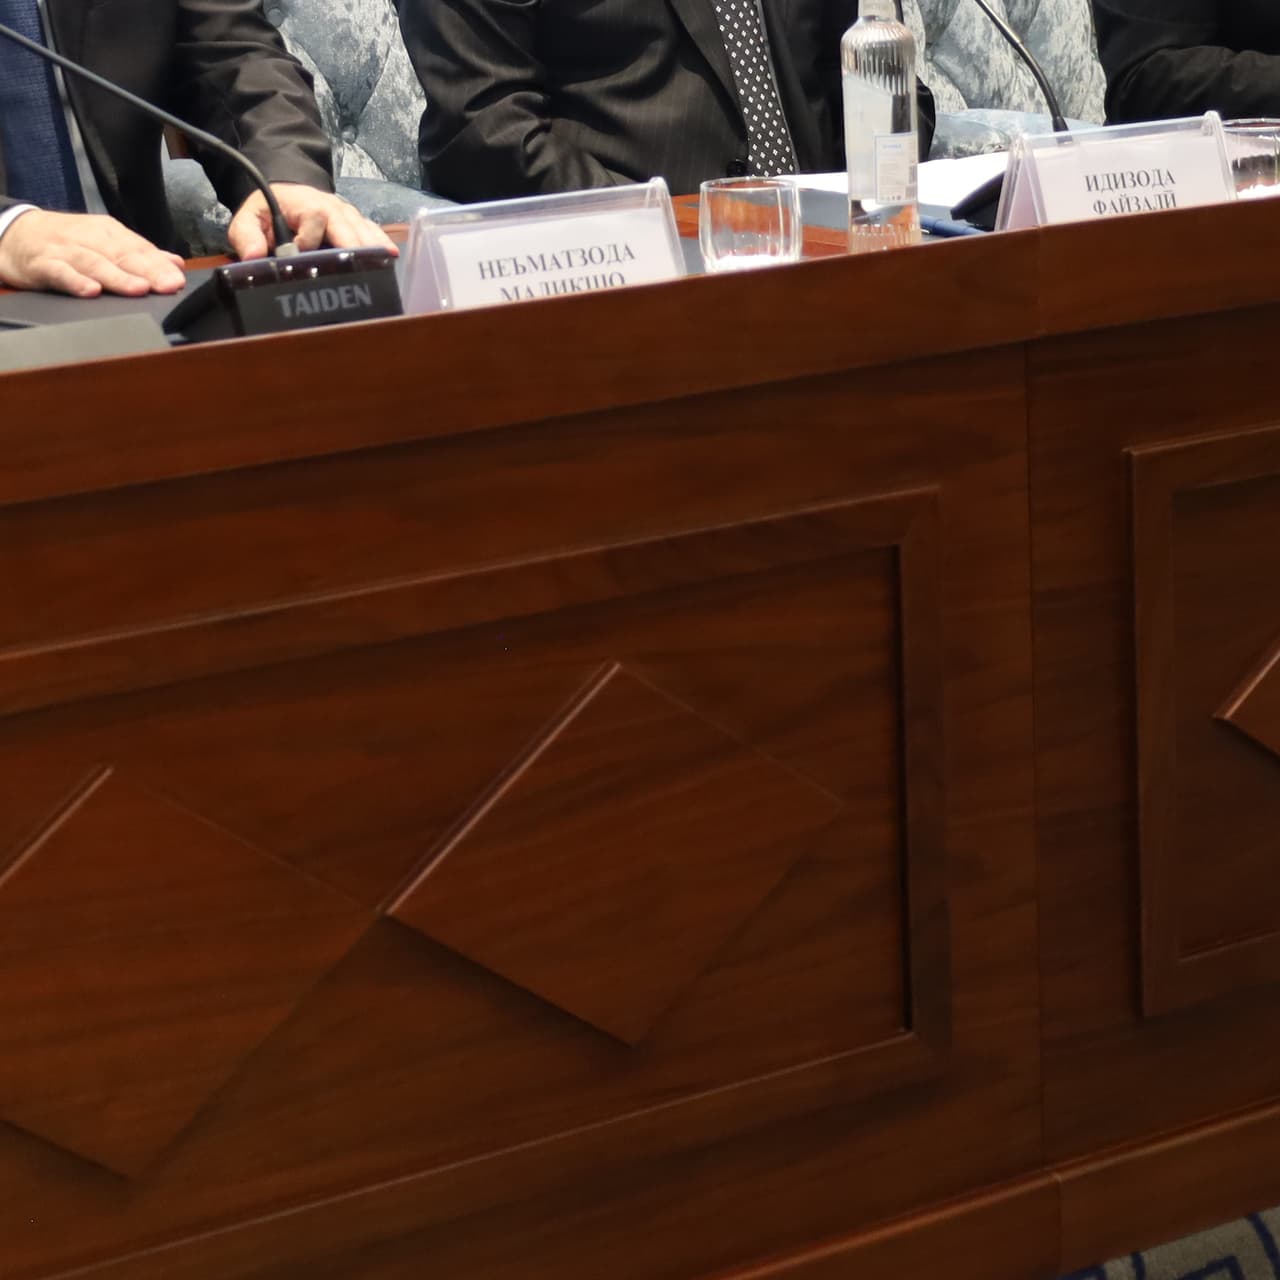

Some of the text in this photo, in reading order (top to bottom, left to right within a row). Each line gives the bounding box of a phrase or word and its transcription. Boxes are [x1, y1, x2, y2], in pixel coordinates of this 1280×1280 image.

[1084, 169, 1176, 192] ИДИЗОДА
[477, 243, 635, 280] НЕЪМАТЗОДА
[275, 283, 372, 318] TAIDEN
